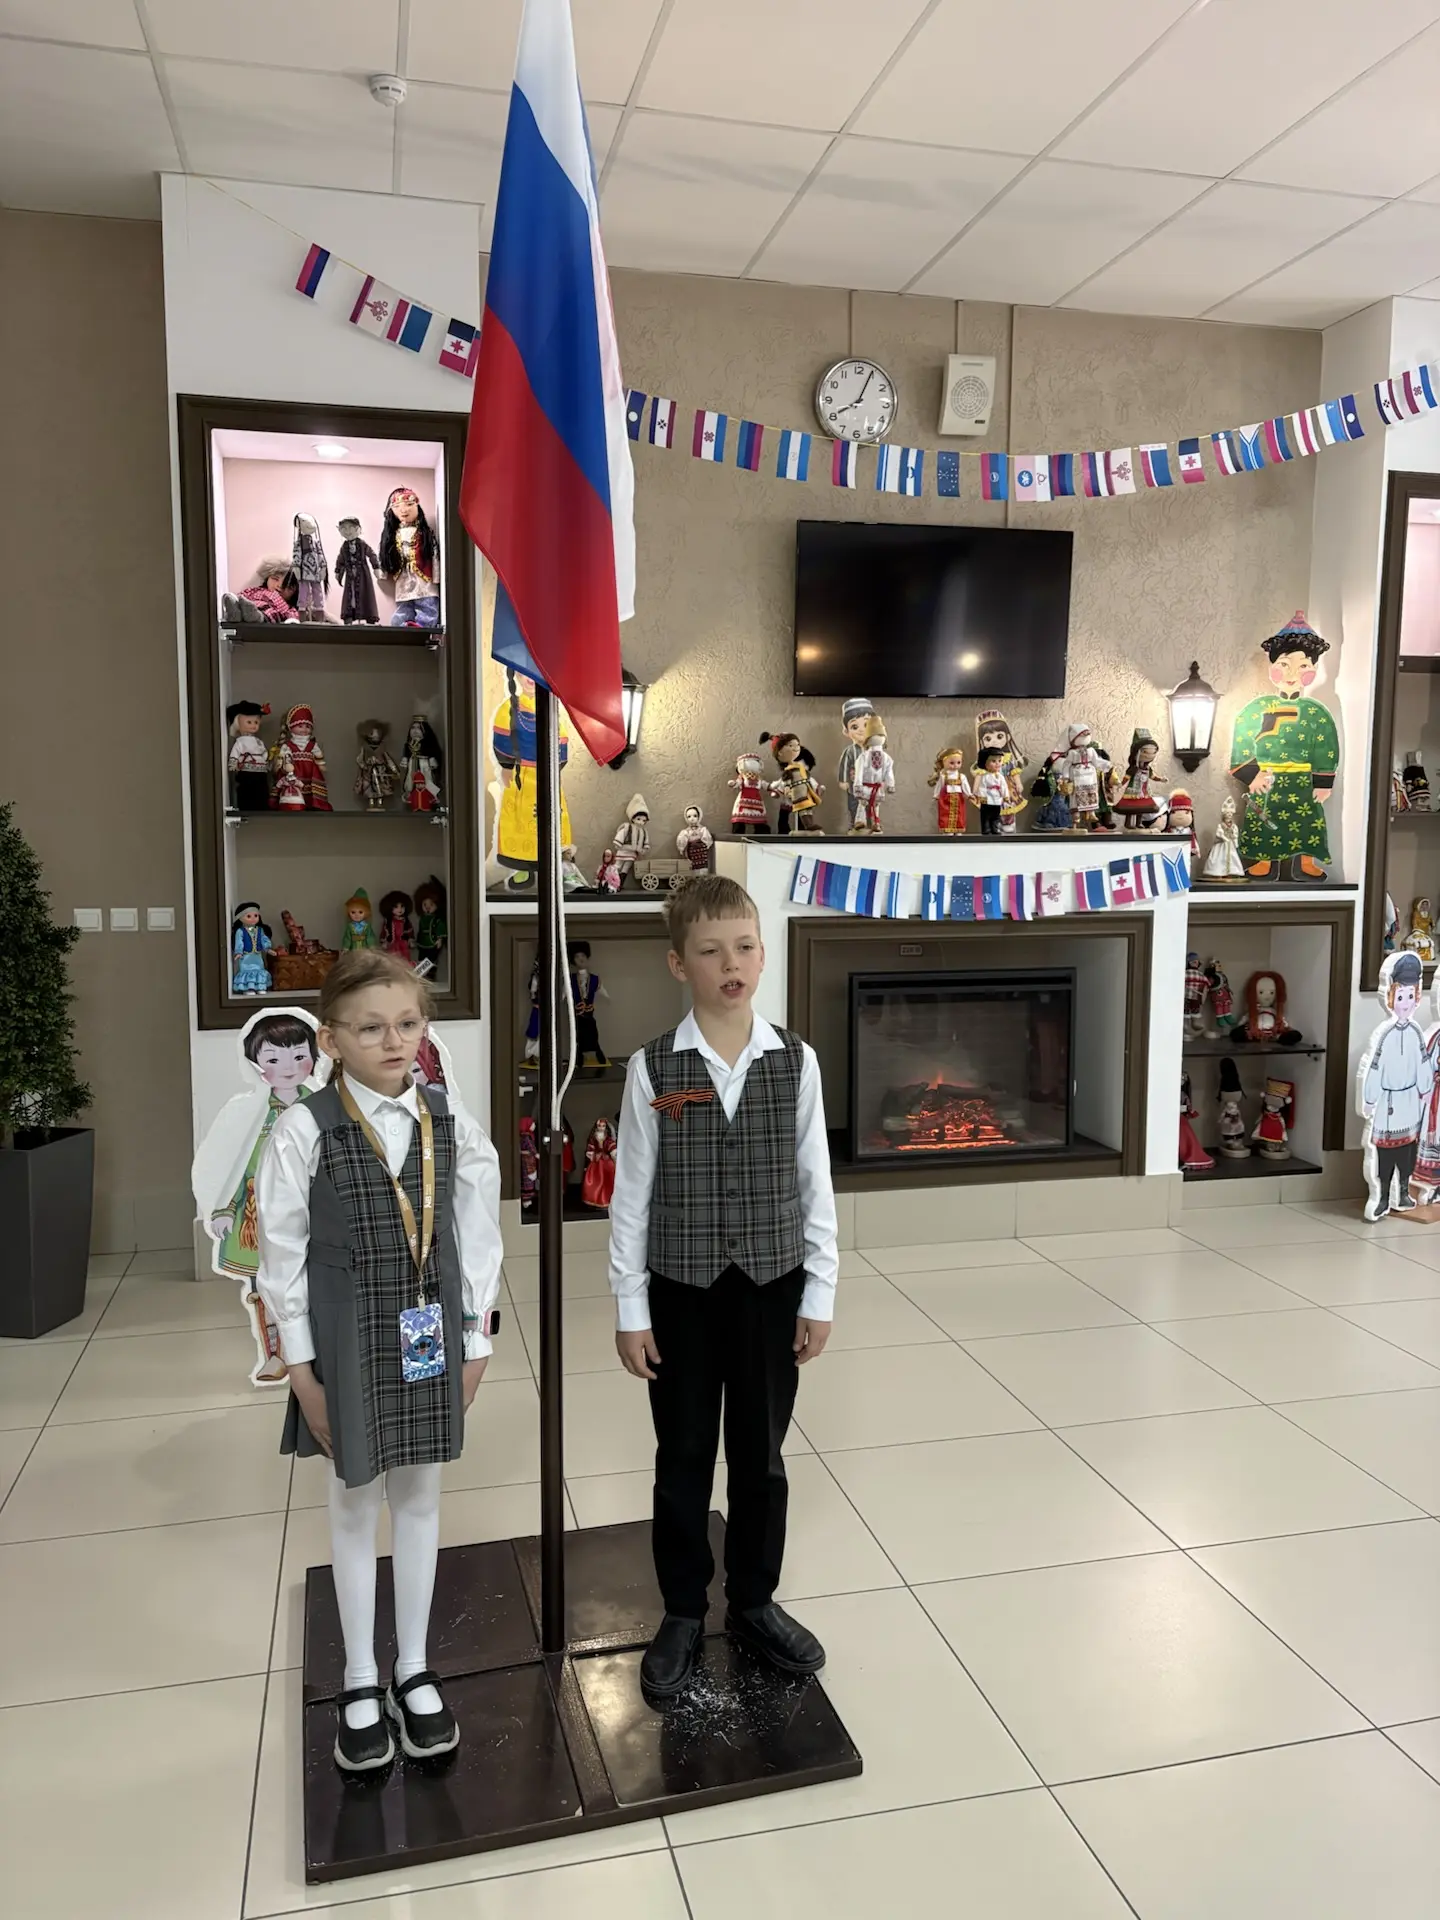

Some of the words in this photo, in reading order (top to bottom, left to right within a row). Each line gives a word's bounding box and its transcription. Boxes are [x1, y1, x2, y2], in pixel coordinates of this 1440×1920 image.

[840, 370, 848, 379] 11
[854, 366, 865, 375] 12
[830, 380, 839, 389] 10
[878, 383, 887, 392] 2
[824, 396, 833, 404] 9
[828, 412, 837, 421] 8
[878, 415, 885, 424] 4
[839, 424, 846, 434] 7
[867, 426, 875, 435] 5
[852, 430, 861, 439] 6
